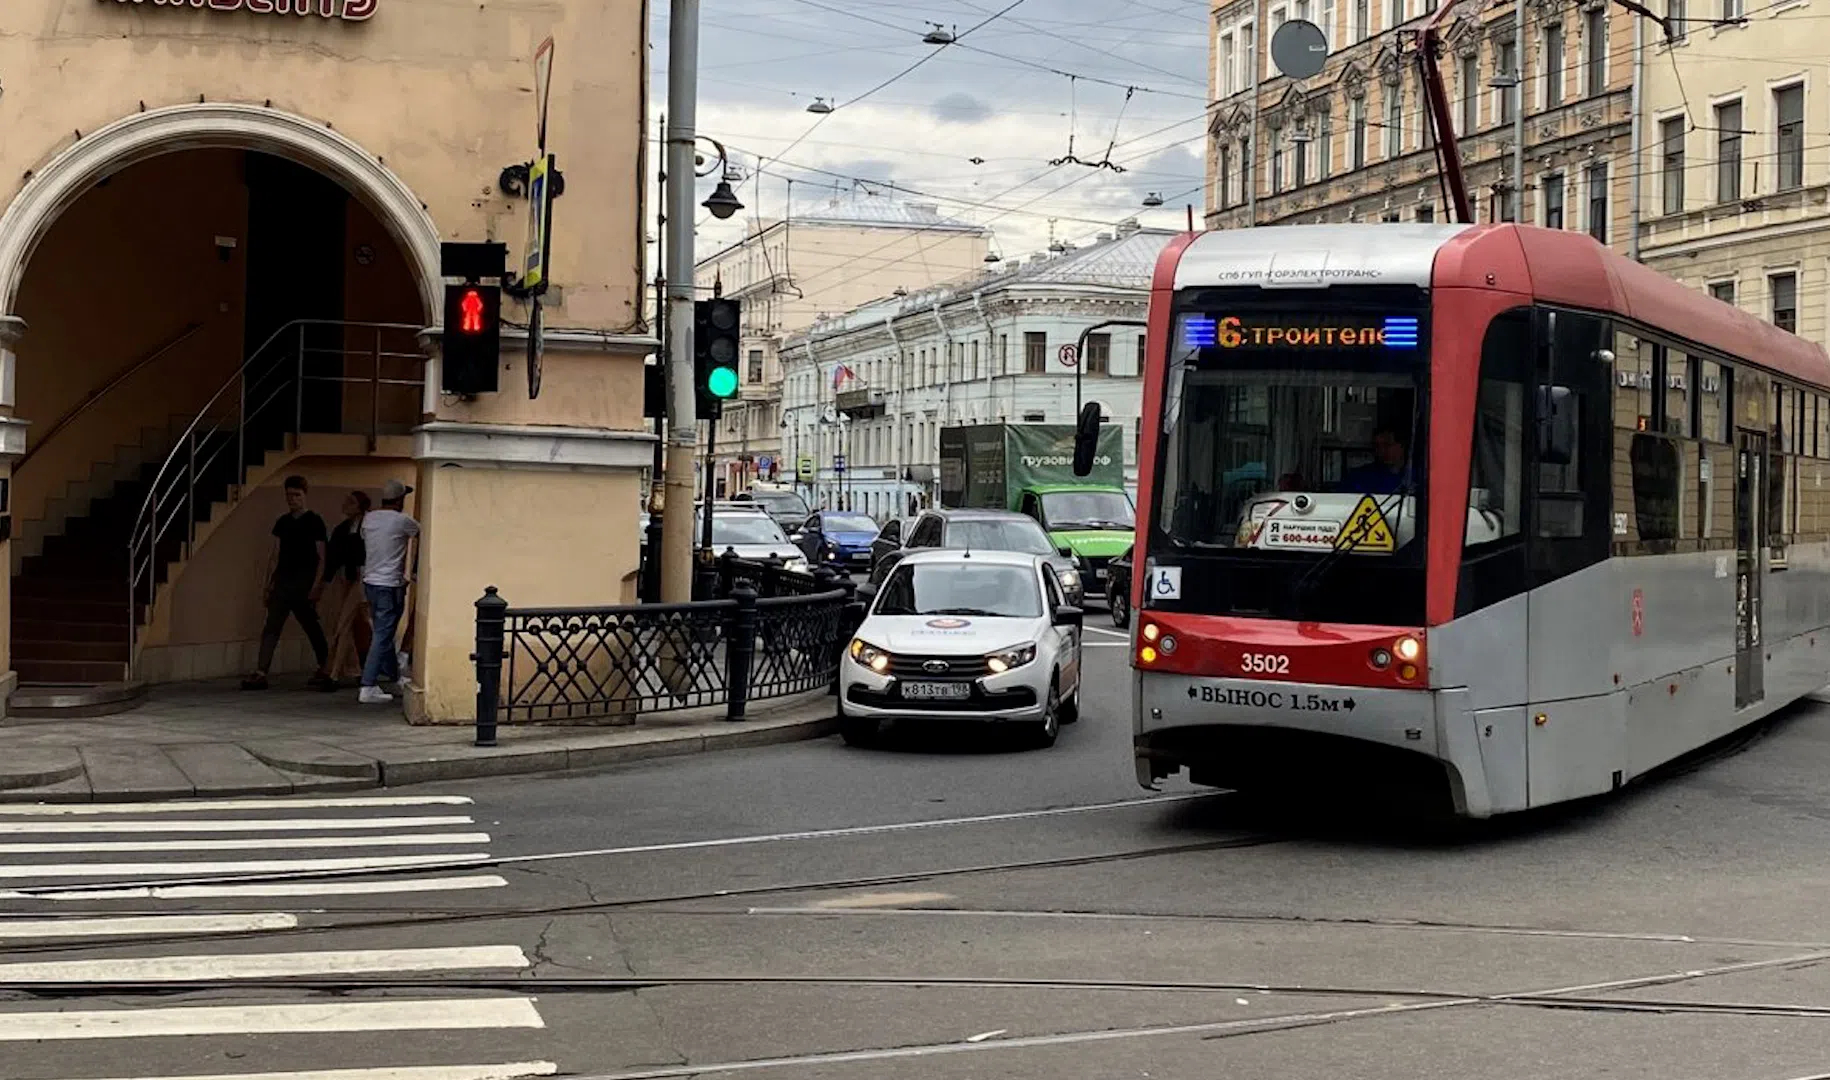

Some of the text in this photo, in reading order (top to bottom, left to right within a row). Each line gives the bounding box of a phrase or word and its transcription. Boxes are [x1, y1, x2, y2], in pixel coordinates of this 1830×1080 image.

[1241, 271, 1262, 279] ГУП
[1218, 316, 1241, 348] 6
[1270, 522, 1280, 533] Я
[1283, 533, 1338, 545] 600-44-00
[1240, 653, 1290, 674] 3502
[1200, 685, 1340, 713] ВЫНОС 1.5м
